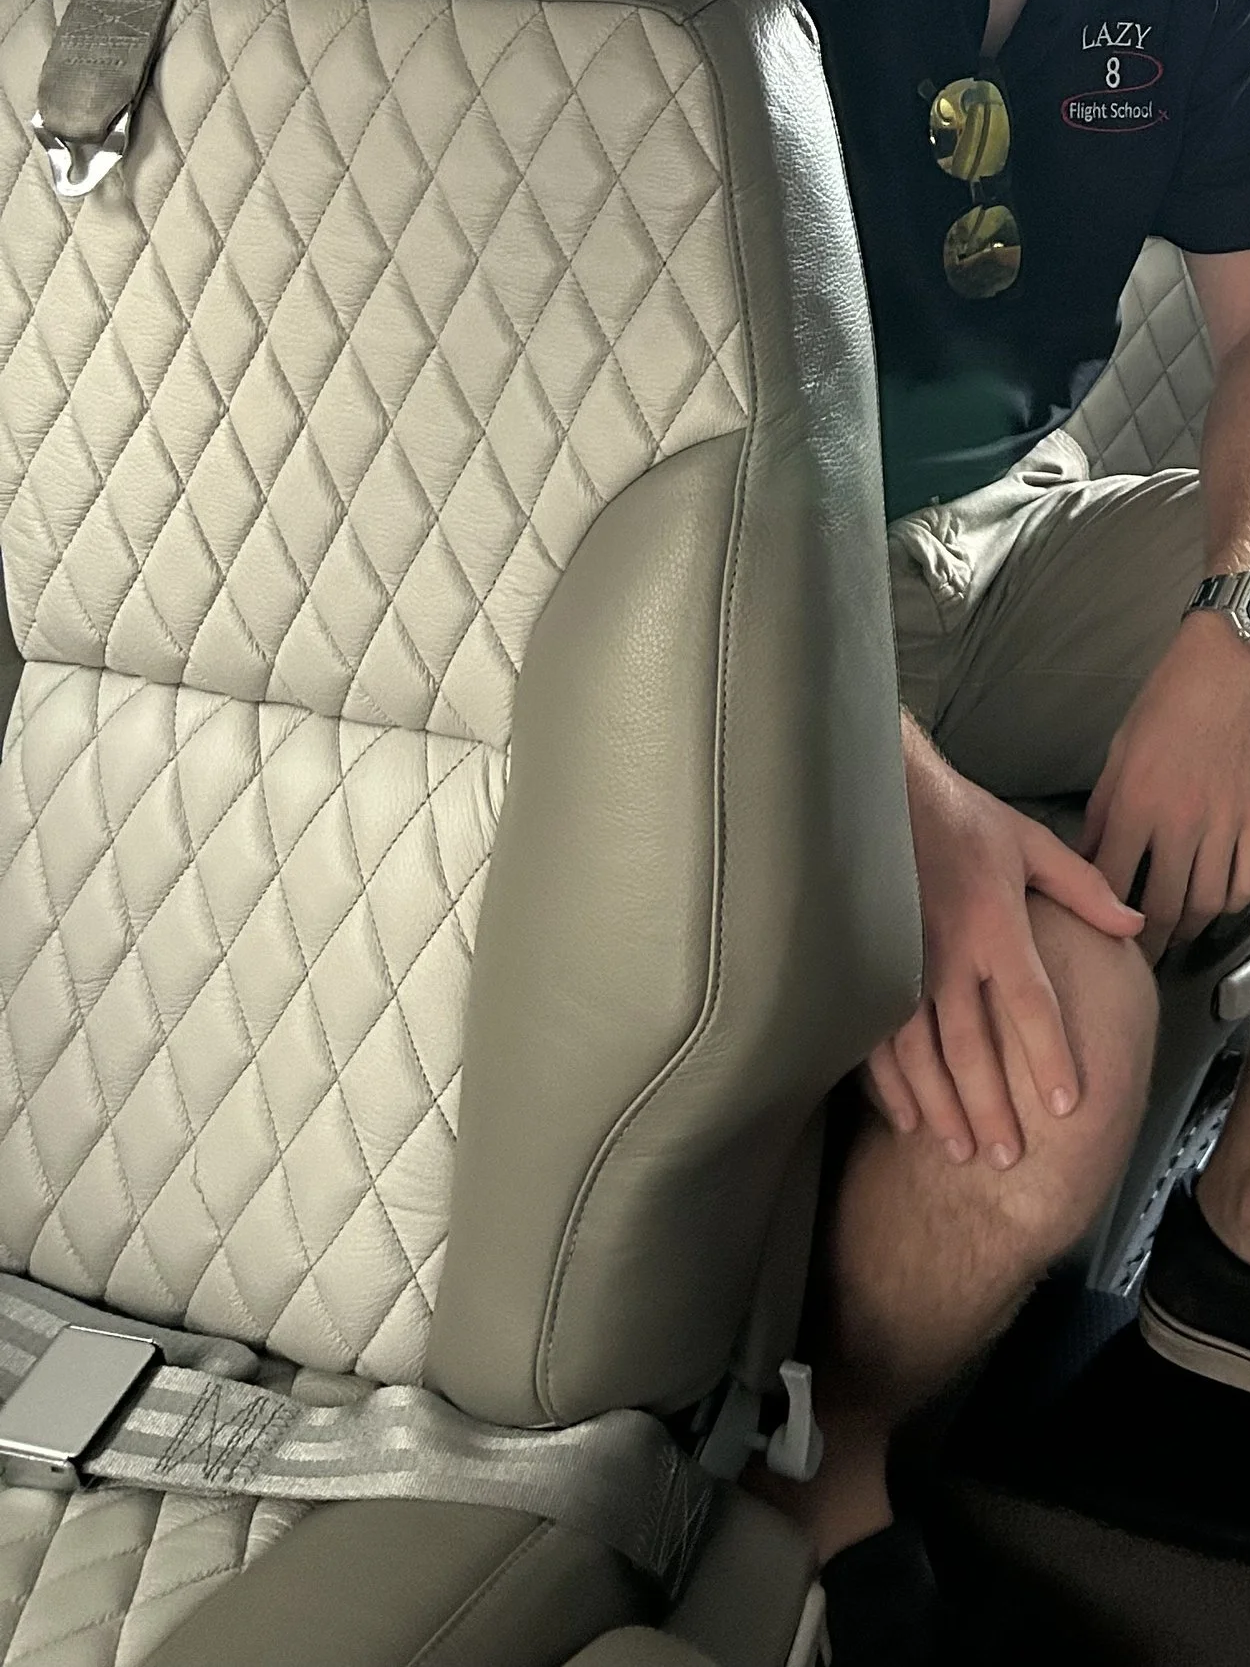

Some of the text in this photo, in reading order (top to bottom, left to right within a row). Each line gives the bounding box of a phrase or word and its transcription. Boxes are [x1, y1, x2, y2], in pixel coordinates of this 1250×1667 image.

[1082, 22, 1152, 50] LAZY
[1105, 56, 1121, 88] 8
[1069, 101, 1153, 122] Flight School
